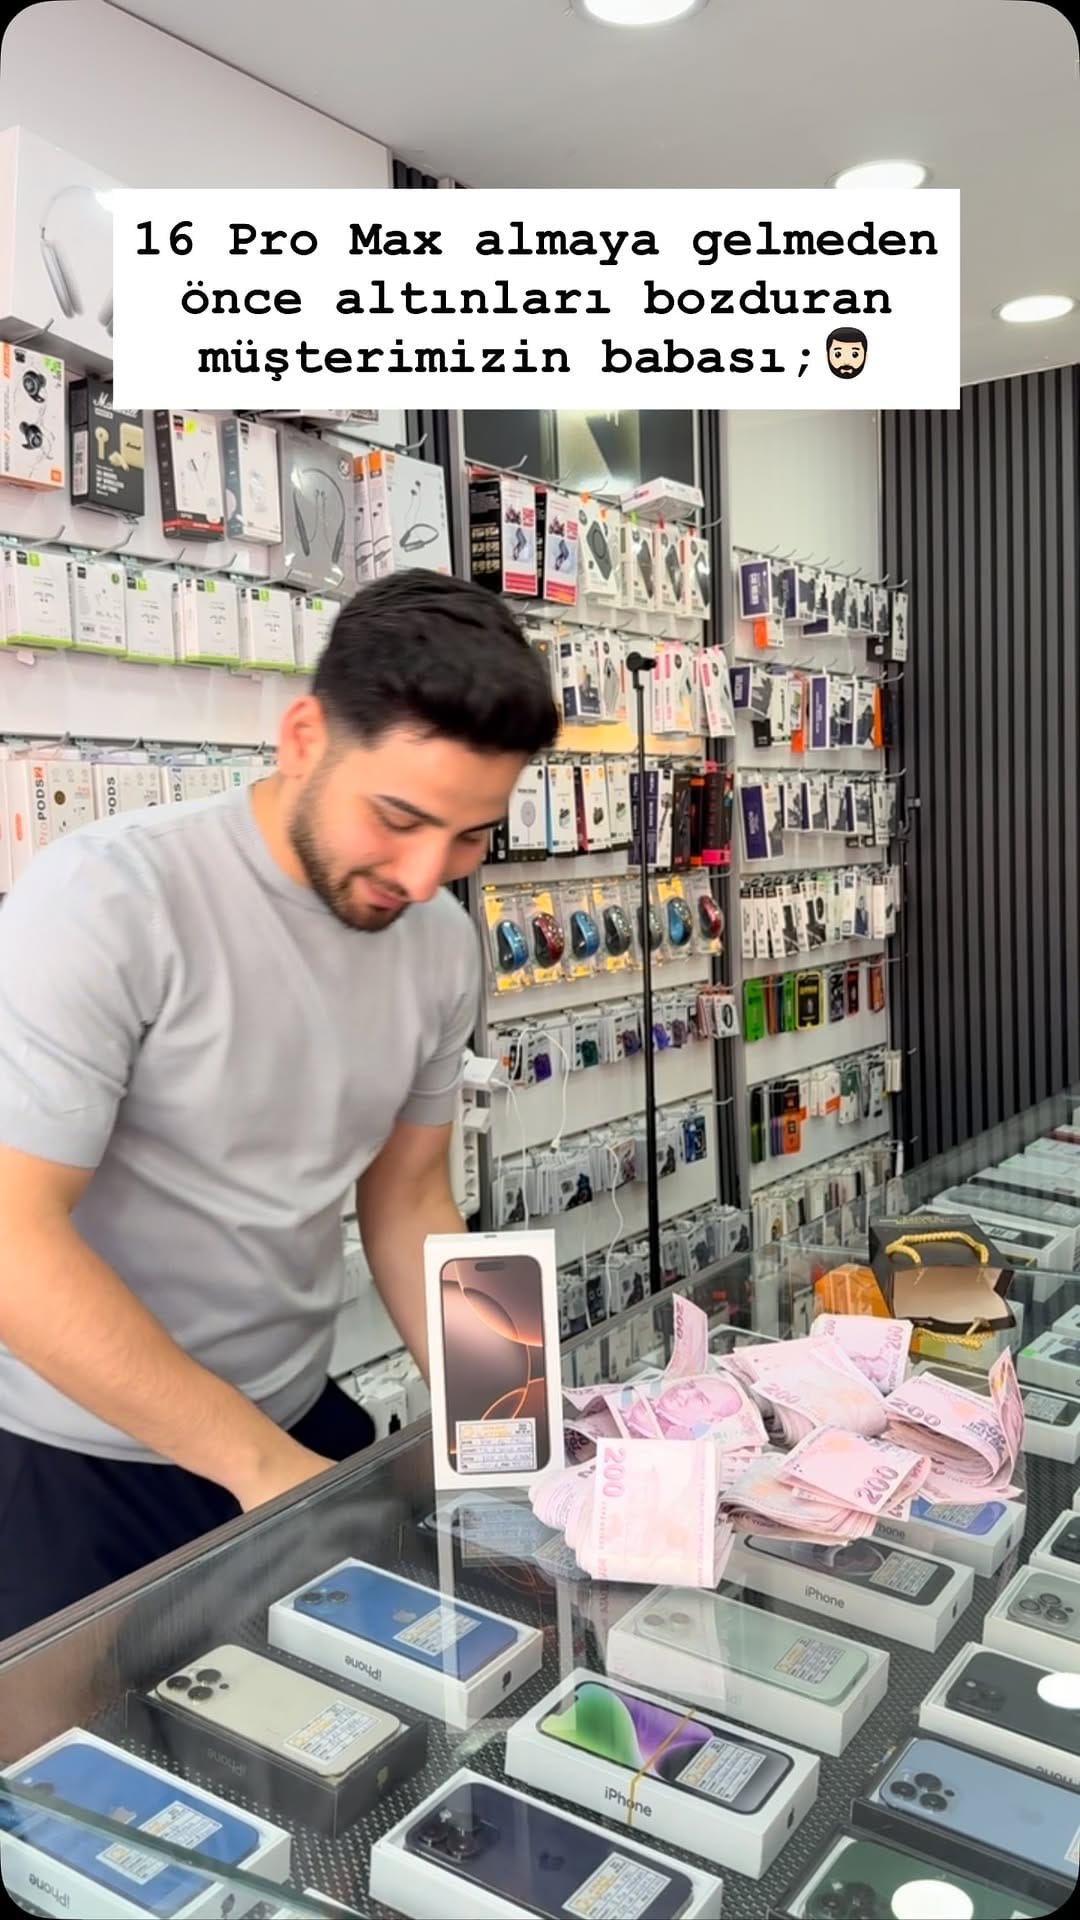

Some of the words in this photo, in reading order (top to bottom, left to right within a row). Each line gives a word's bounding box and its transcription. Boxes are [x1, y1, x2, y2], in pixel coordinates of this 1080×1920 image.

[886, 1325, 905, 1351] 200
[763, 1383, 801, 1405] 200
[889, 1396, 942, 1428] 200
[602, 1447, 625, 1498] 200
[853, 1464, 899, 1506] 200
[804, 1582, 846, 1609] iPhone
[344, 1653, 384, 1682] iPhone
[604, 1786, 652, 1817] iPhone
[28, 1872, 71, 1910] iPhone
